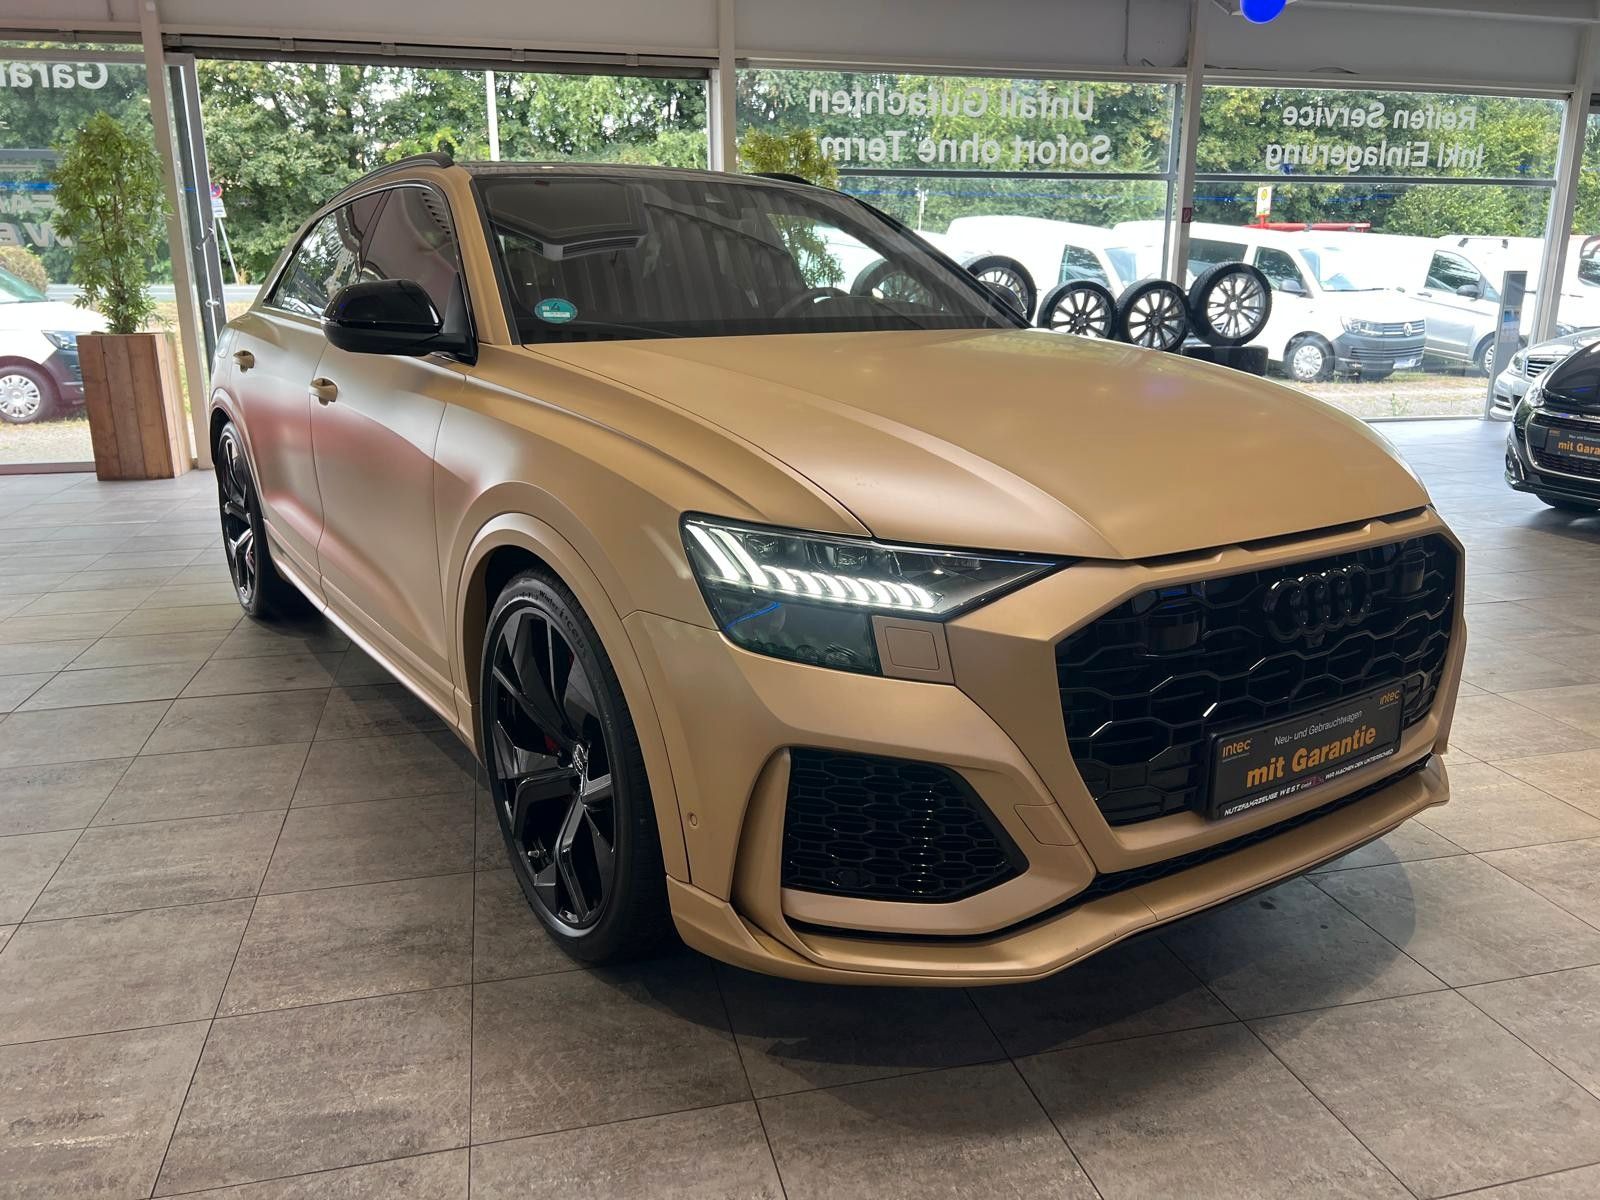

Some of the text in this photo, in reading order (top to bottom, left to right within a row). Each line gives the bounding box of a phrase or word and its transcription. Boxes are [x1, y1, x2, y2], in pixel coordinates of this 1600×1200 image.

[1558, 441, 1573, 451] mit
[1274, 711, 1363, 747] Neu- und Gebrauchtwagen
[1222, 740, 1252, 758] intec
[1246, 724, 1377, 788] mit Garantie
[1280, 783, 1301, 796] WEST
